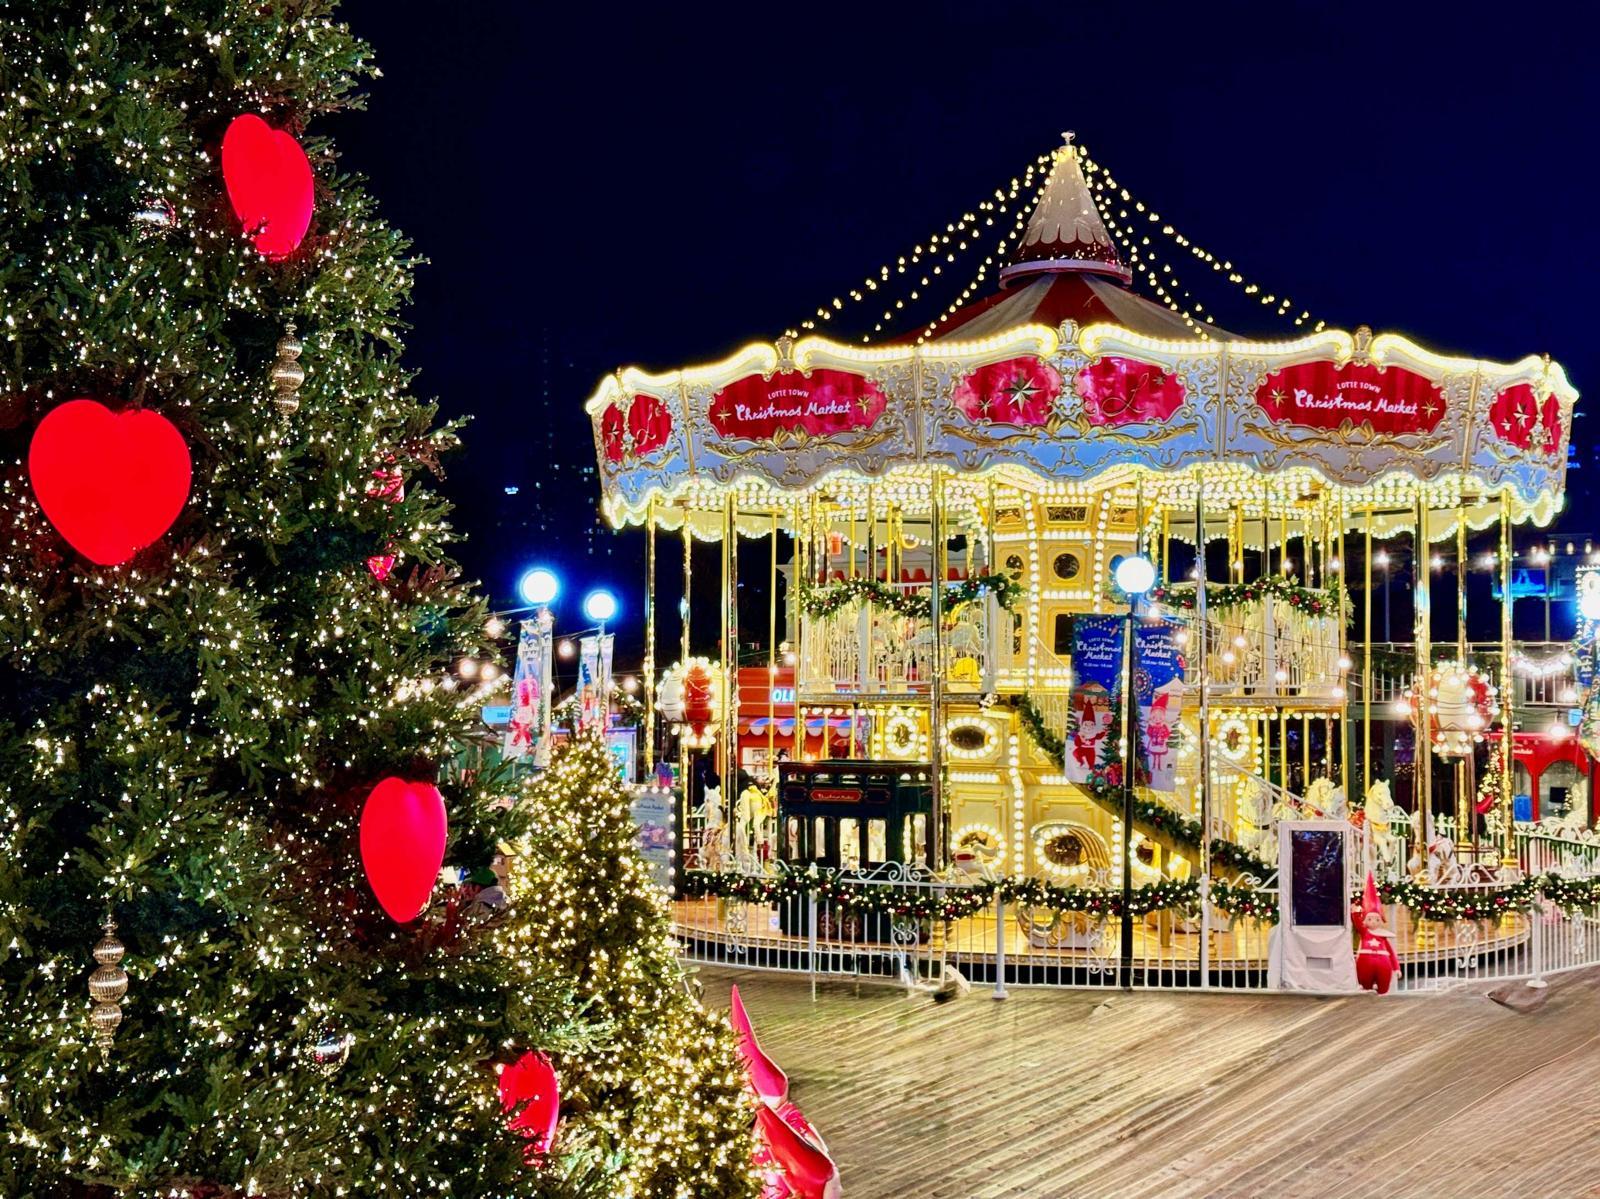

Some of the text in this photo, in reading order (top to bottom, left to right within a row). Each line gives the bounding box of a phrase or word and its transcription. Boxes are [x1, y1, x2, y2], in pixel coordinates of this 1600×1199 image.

[1336, 381, 1381, 393] LOTTE TOWN
[768, 389, 809, 400] LOTTE TOWN
[1294, 388, 1418, 415] Christmas Market
[735, 399, 851, 421] Christmas Market
[1076, 640, 1122, 652] Christmas
[1084, 651, 1112, 660] Market
[1142, 649, 1171, 658] Market
[772, 689, 794, 702] OLI
